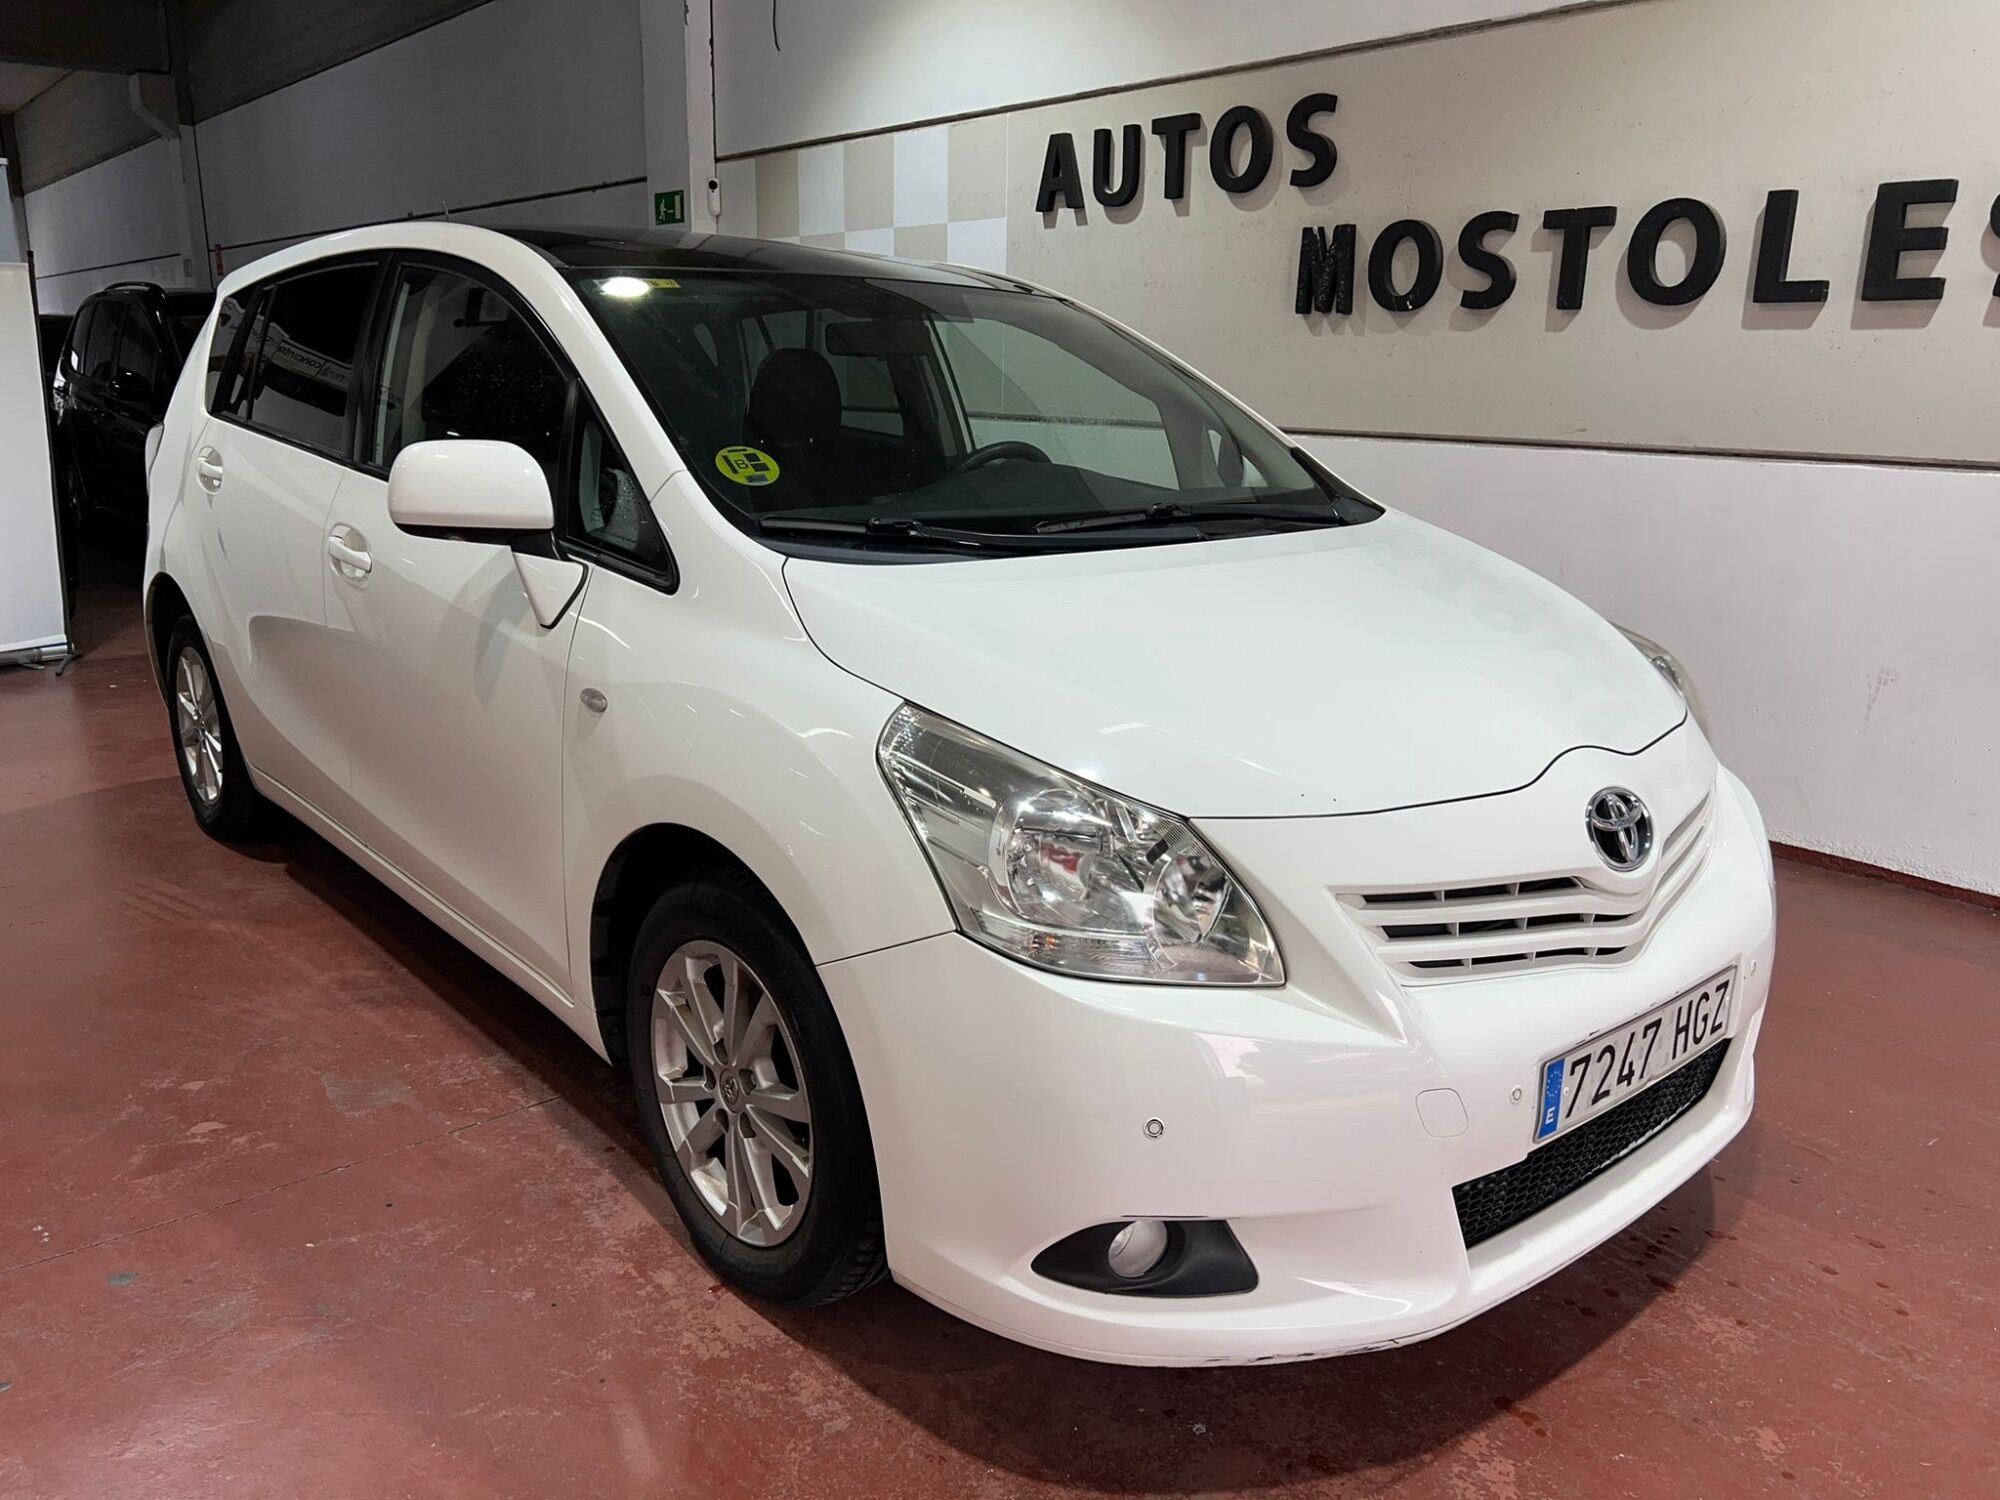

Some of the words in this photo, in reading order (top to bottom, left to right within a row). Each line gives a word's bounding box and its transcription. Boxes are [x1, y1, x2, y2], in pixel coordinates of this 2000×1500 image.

[1036, 92, 1338, 213] AUTOS
[1295, 178, 2000, 315] MOSTOLE
[1565, 1017, 1662, 1118] 7247
[1672, 979, 1730, 1060] HGZ
[1544, 1106, 1556, 1125] E
